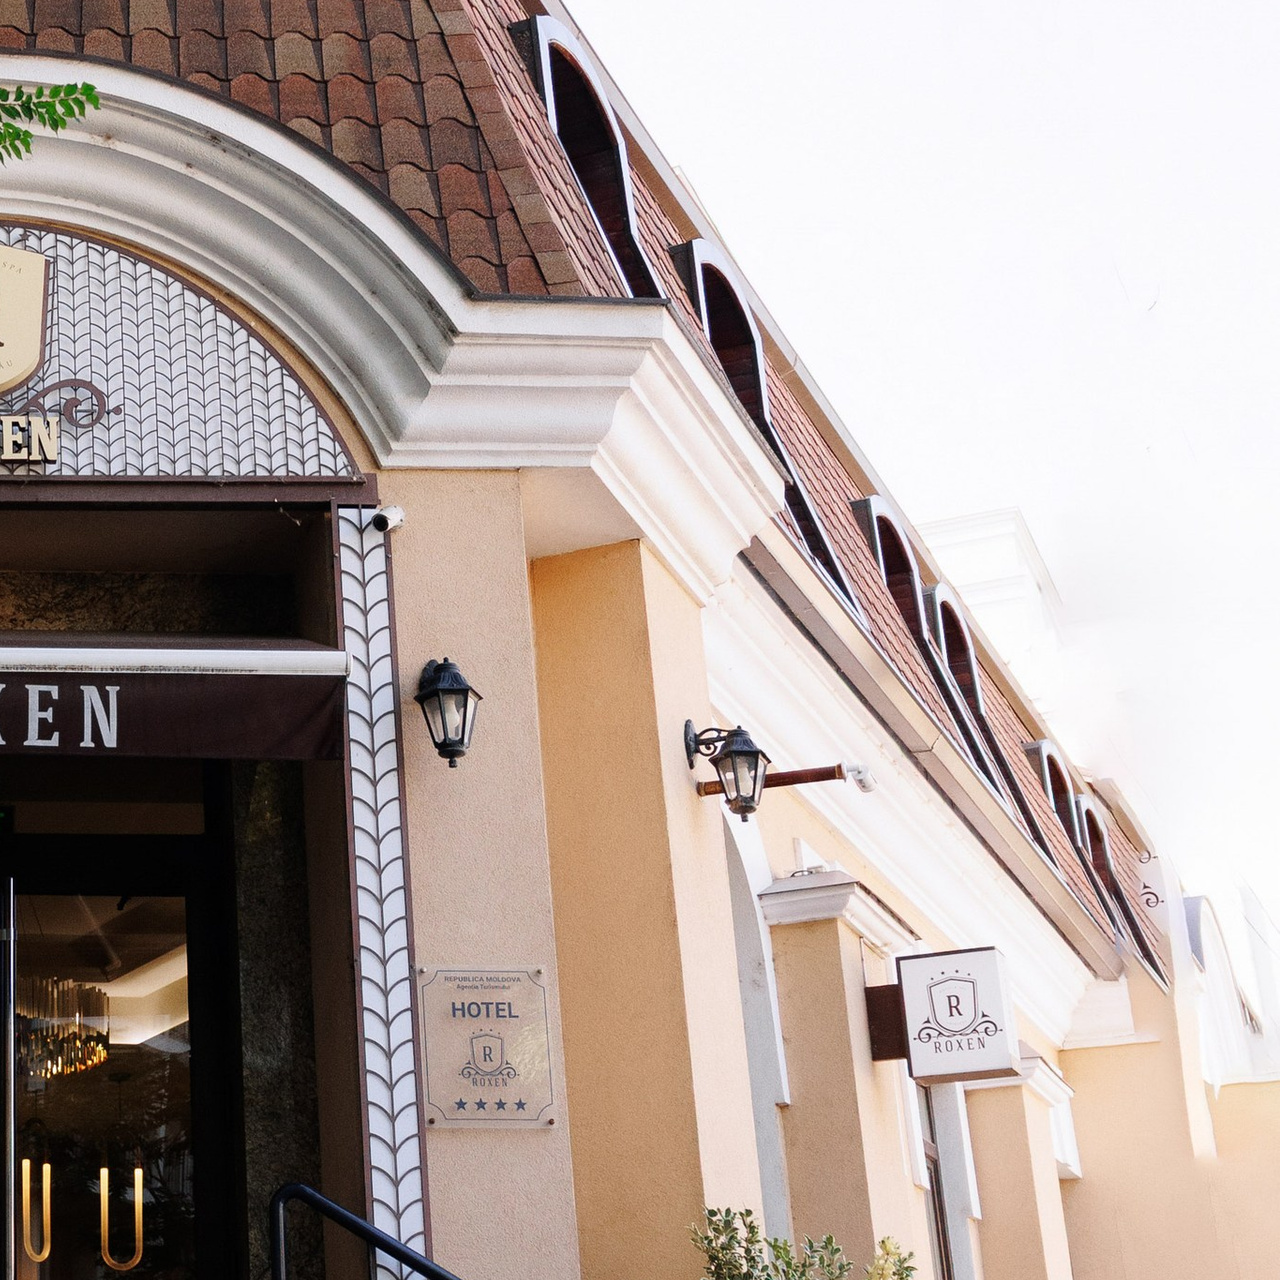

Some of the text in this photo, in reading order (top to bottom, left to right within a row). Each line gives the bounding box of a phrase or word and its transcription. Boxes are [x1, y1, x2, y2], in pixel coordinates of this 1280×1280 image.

[2, 261, 22, 274] SPA
[451, 1001, 519, 1019] HOTEL
[946, 994, 963, 1018] R
[482, 1045, 494, 1063] R
[934, 1036, 986, 1054] ROXEN
[472, 1077, 508, 1087] ROXEN
